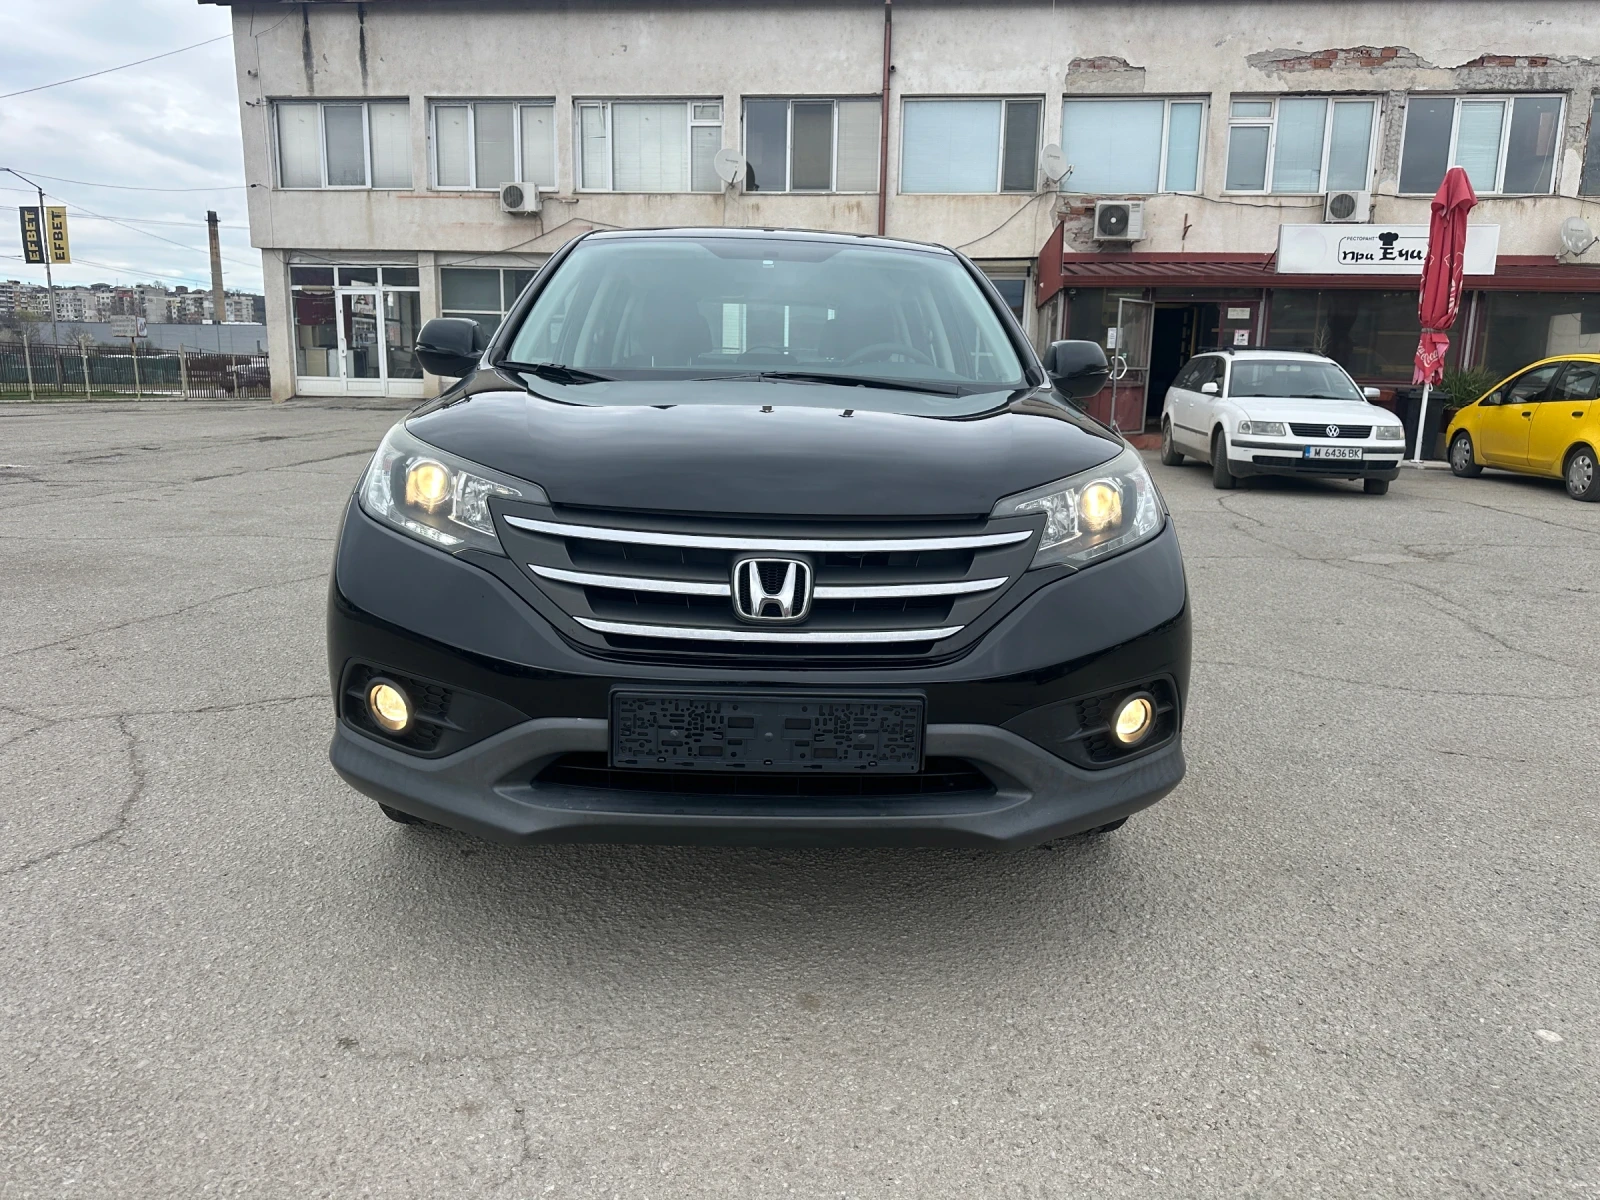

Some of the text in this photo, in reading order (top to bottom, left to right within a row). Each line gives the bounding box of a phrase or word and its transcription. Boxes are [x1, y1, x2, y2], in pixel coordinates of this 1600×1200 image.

[24, 210, 40, 261] EFBET
[51, 210, 66, 261] EFBET
[1325, 449, 1347, 458] 6436
